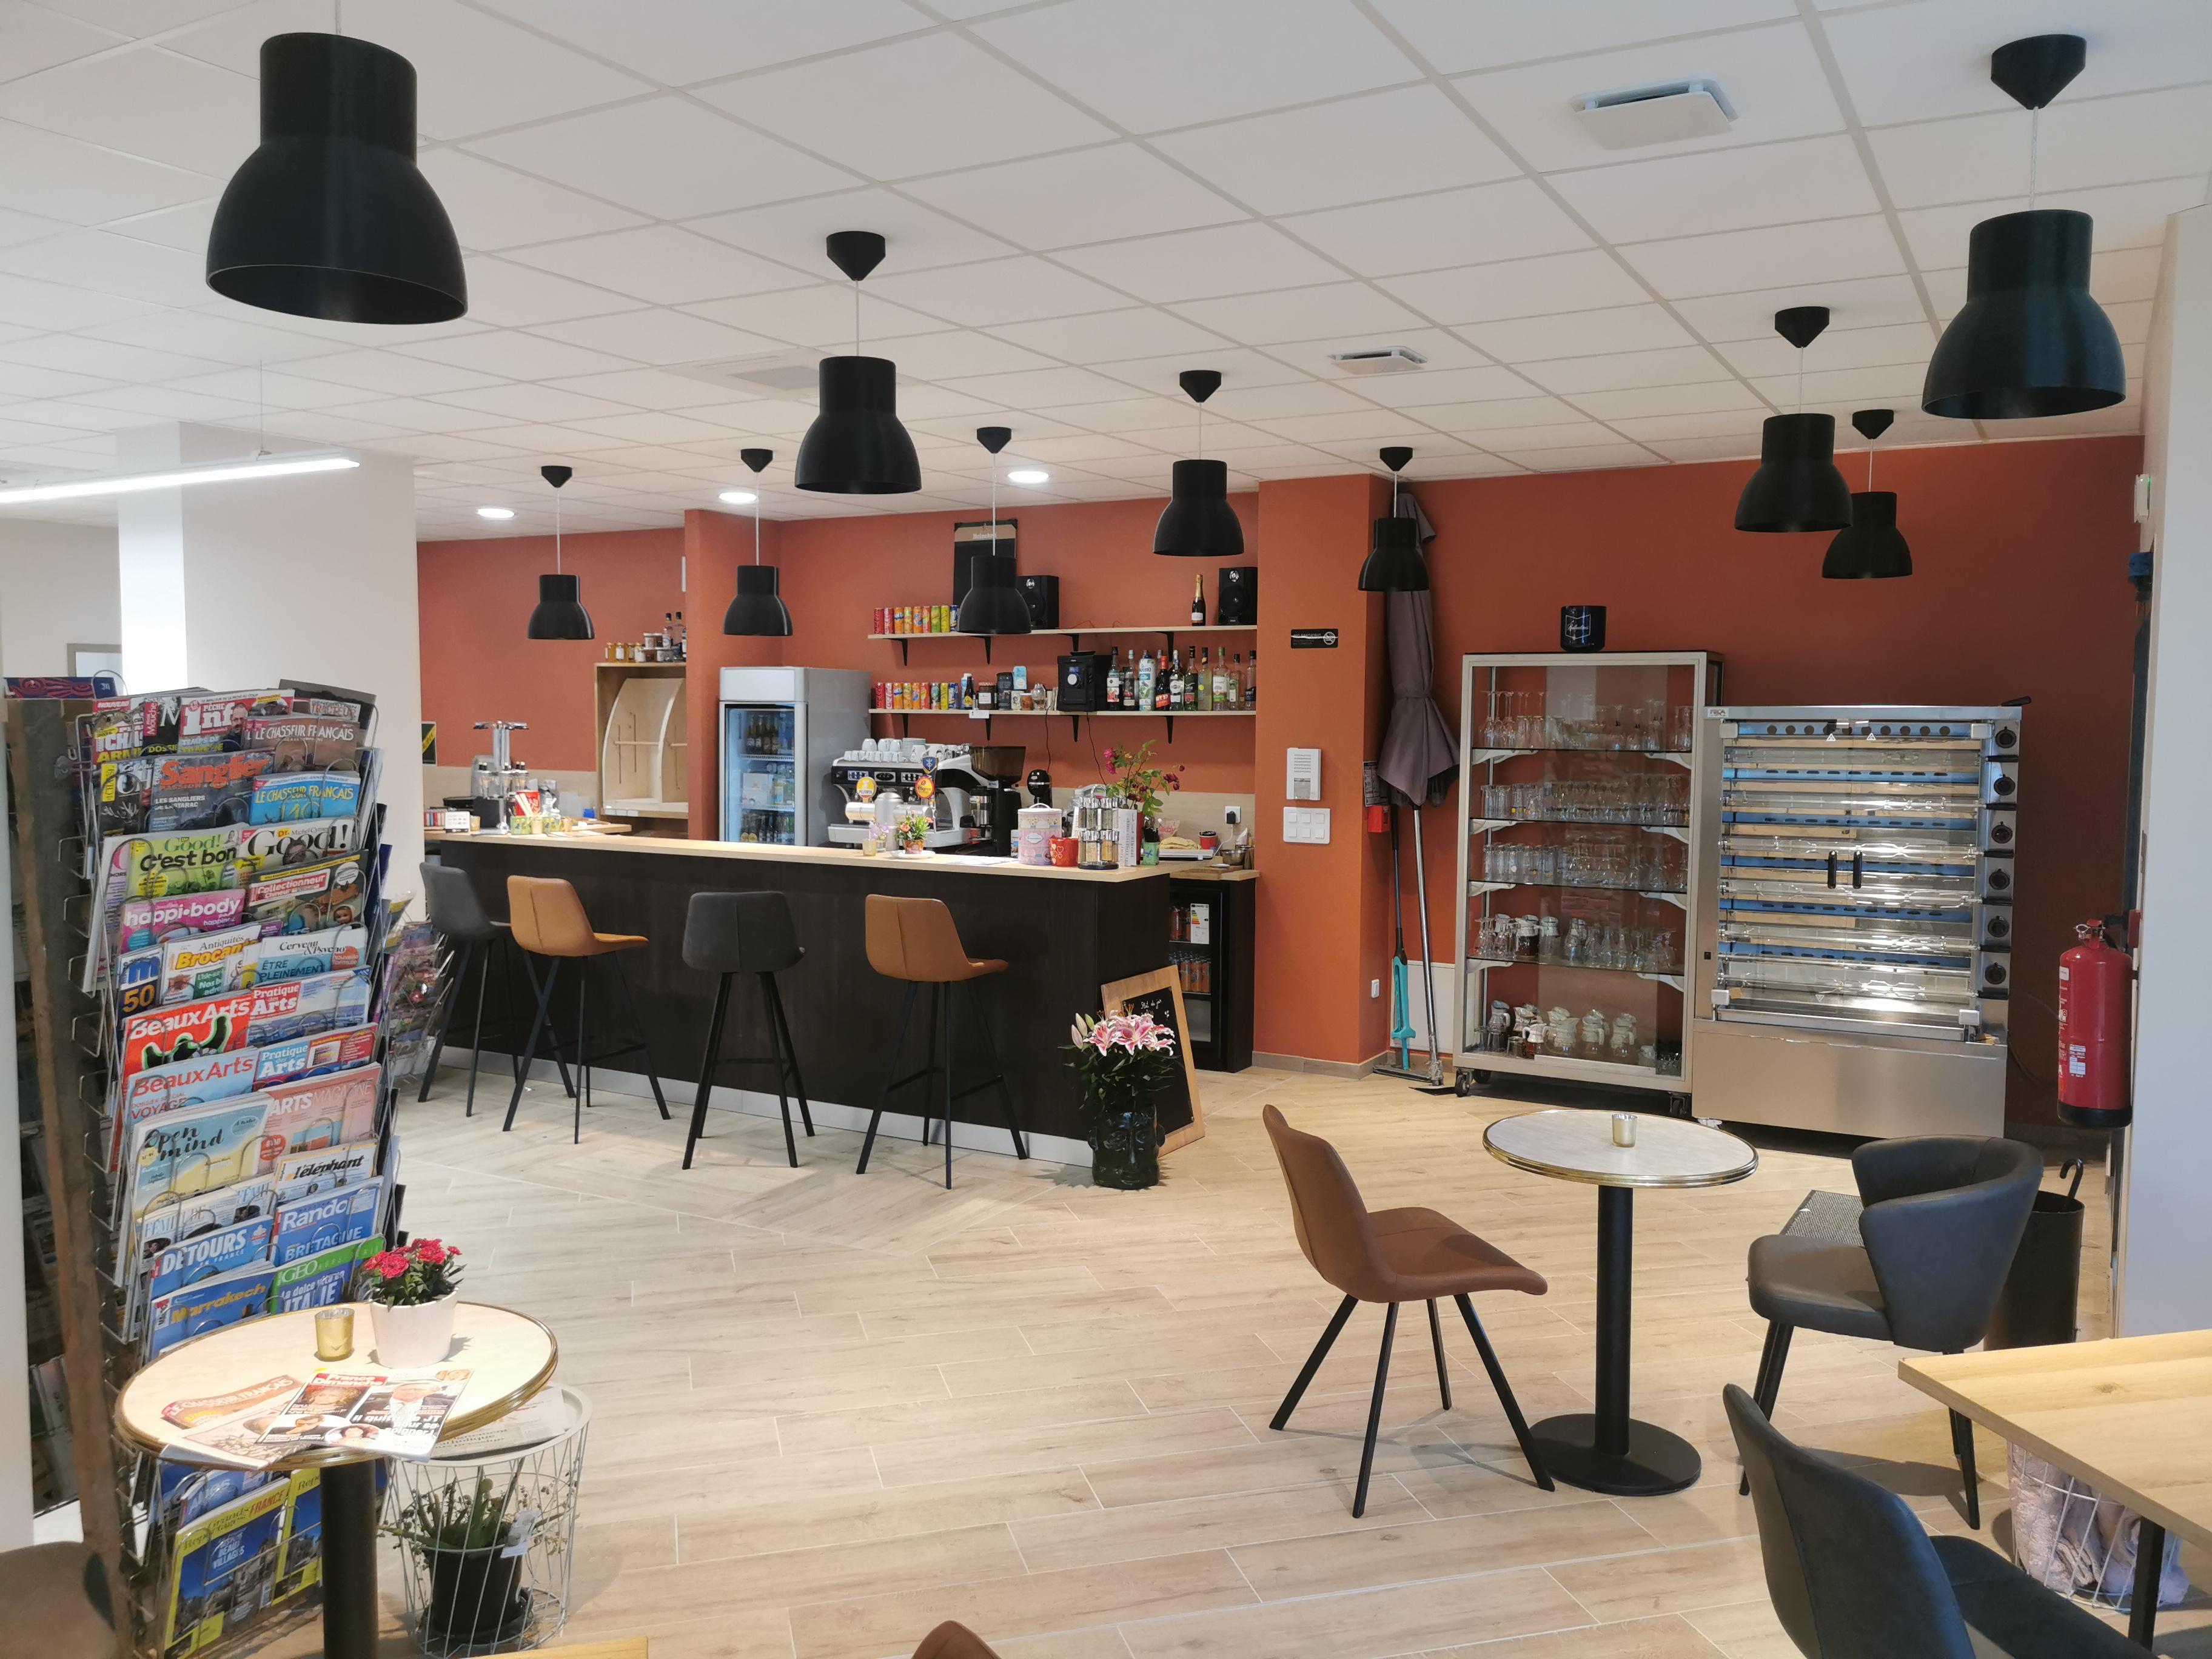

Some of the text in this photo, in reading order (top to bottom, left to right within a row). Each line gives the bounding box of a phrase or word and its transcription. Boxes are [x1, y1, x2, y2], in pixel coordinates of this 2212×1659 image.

[267, 724, 305, 739] CHASSEUR
[307, 725, 354, 742] FRANÇAIS
[309, 785, 354, 800] FRANÇAIS
[165, 834, 221, 852] Good!
[140, 847, 237, 871] C'est bon
[258, 875, 326, 894] Collectionneur
[199, 935, 244, 951] Antiquités
[280, 940, 318, 951] Cerveau
[175, 940, 258, 970] Brocan
[260, 964, 324, 980] PLEINEMENT
[262, 960, 288, 970] ÊTRE
[199, 980, 214, 989] Nos
[253, 985, 300, 999] Pratique
[122, 984, 155, 1013] 50
[251, 997, 298, 1016] Arts
[262, 1045, 309, 1061] Pratique
[260, 1057, 306, 1078] Arts
[282, 1197, 351, 1232] Rando
[293, 1281, 315, 1295] dolce
